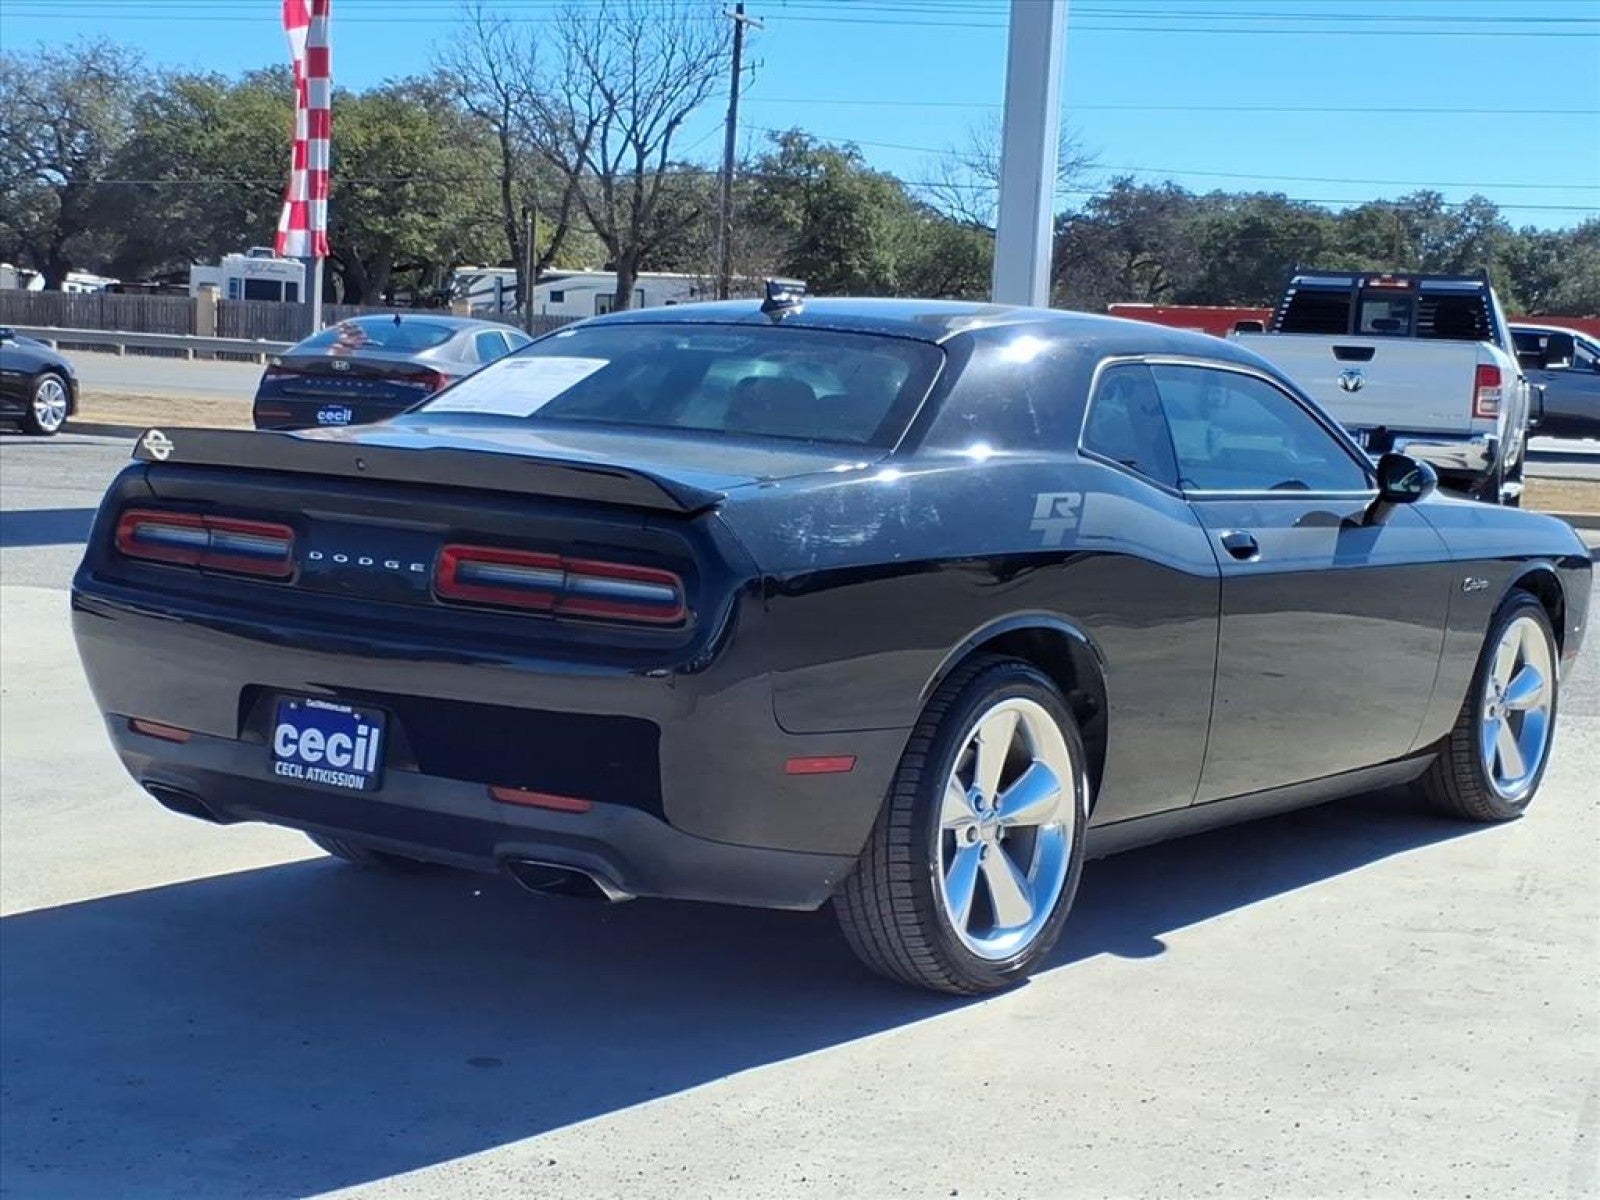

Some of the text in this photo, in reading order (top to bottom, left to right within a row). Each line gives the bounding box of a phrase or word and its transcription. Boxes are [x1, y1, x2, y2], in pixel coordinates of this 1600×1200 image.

[317, 409, 352, 421] cecil
[309, 551, 425, 572] DODGE
[275, 723, 379, 773] cecil
[275, 761, 365, 790] CECIL ATKISSION
